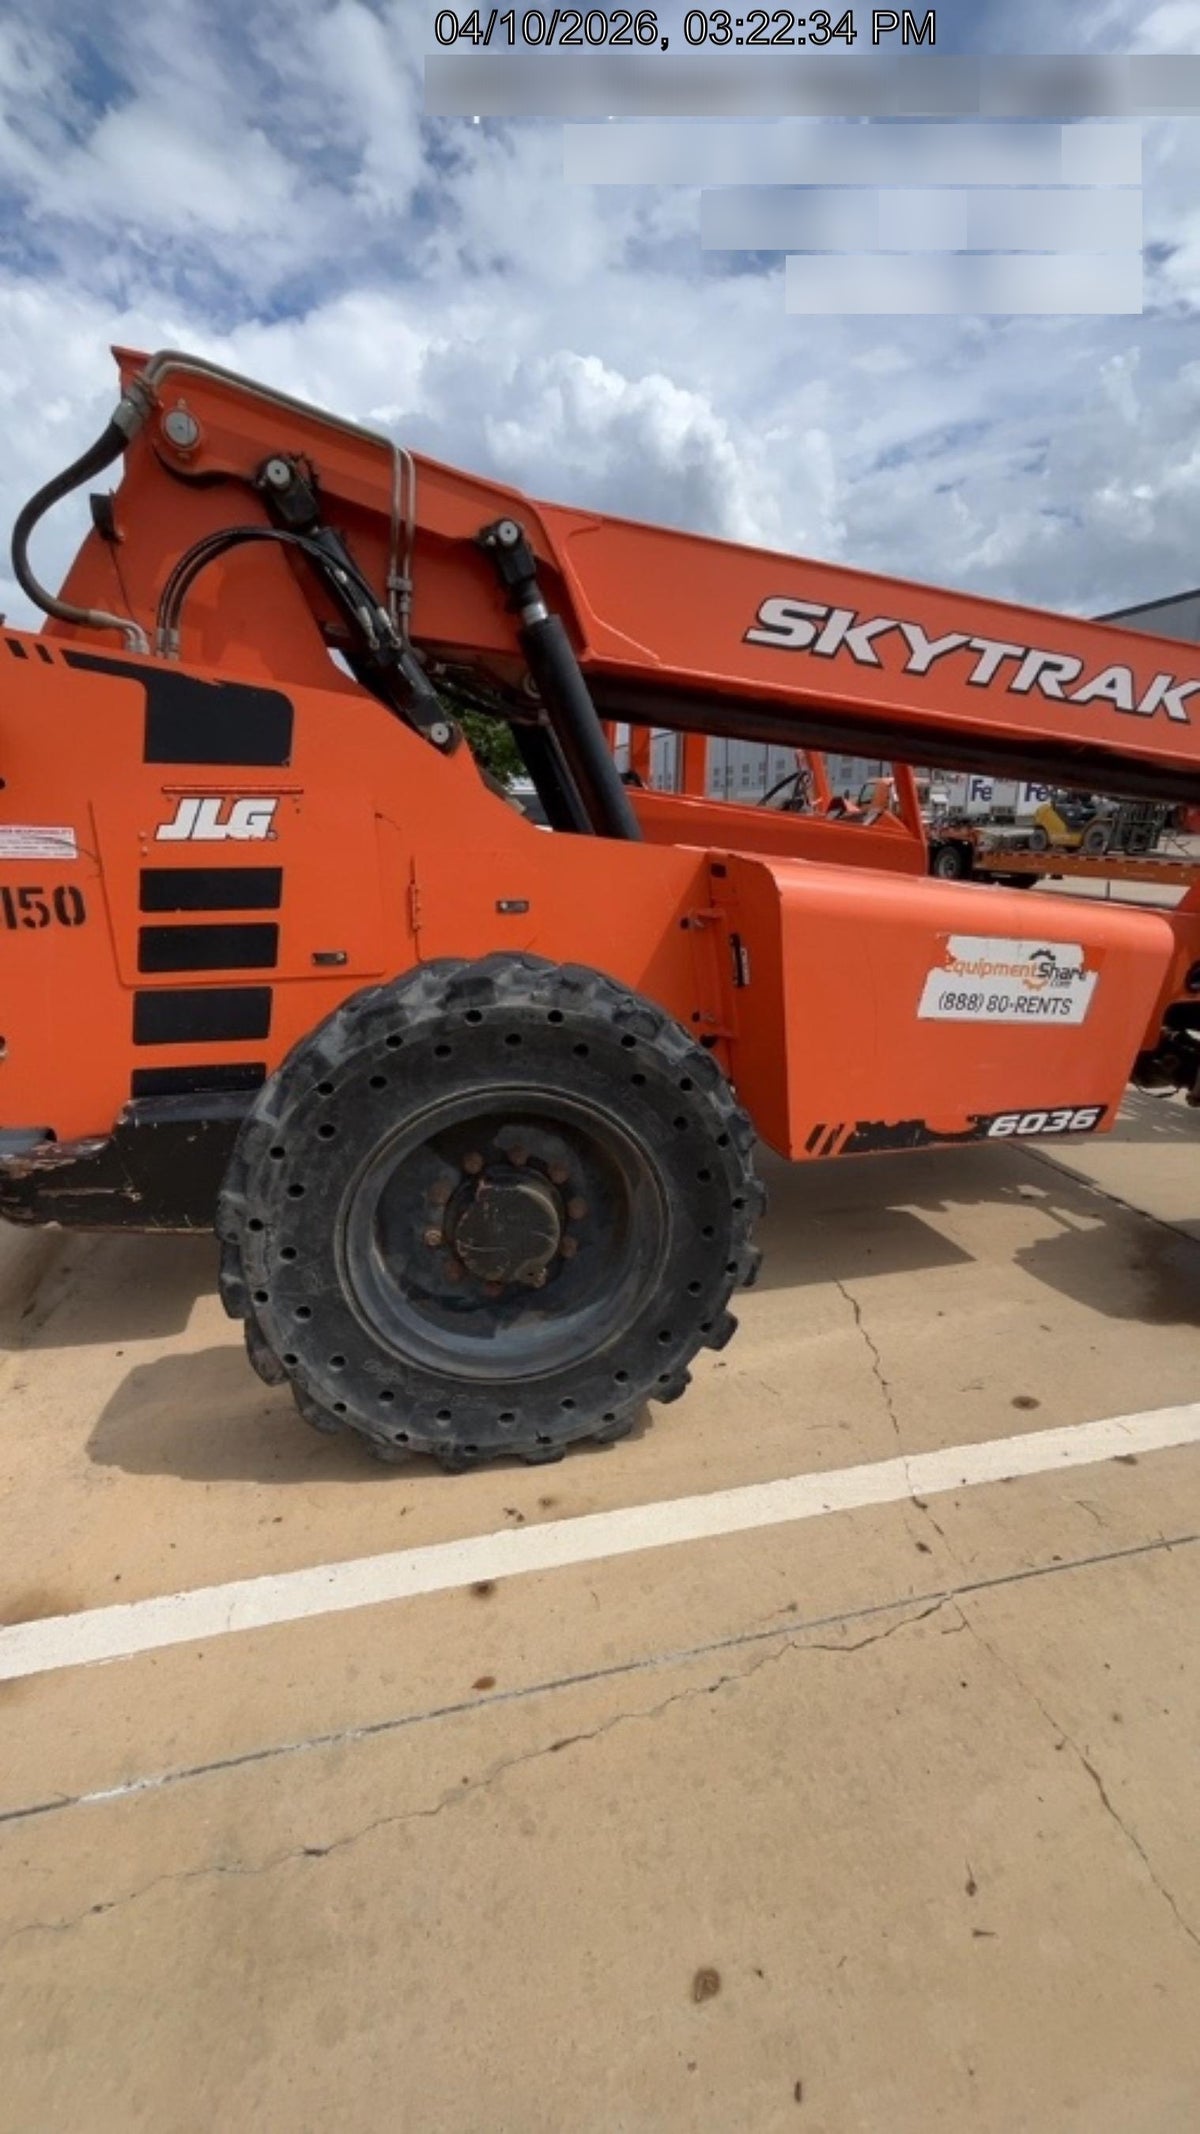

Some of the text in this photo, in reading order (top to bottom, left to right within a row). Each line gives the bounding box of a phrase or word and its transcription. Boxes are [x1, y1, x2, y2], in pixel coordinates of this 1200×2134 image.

[743, 596, 1200, 723] SKYTRAK
[154, 797, 278, 841] JLG
[938, 991, 1073, 1016] (888) 80-RENTS
[987, 1108, 1101, 1137] 6036
